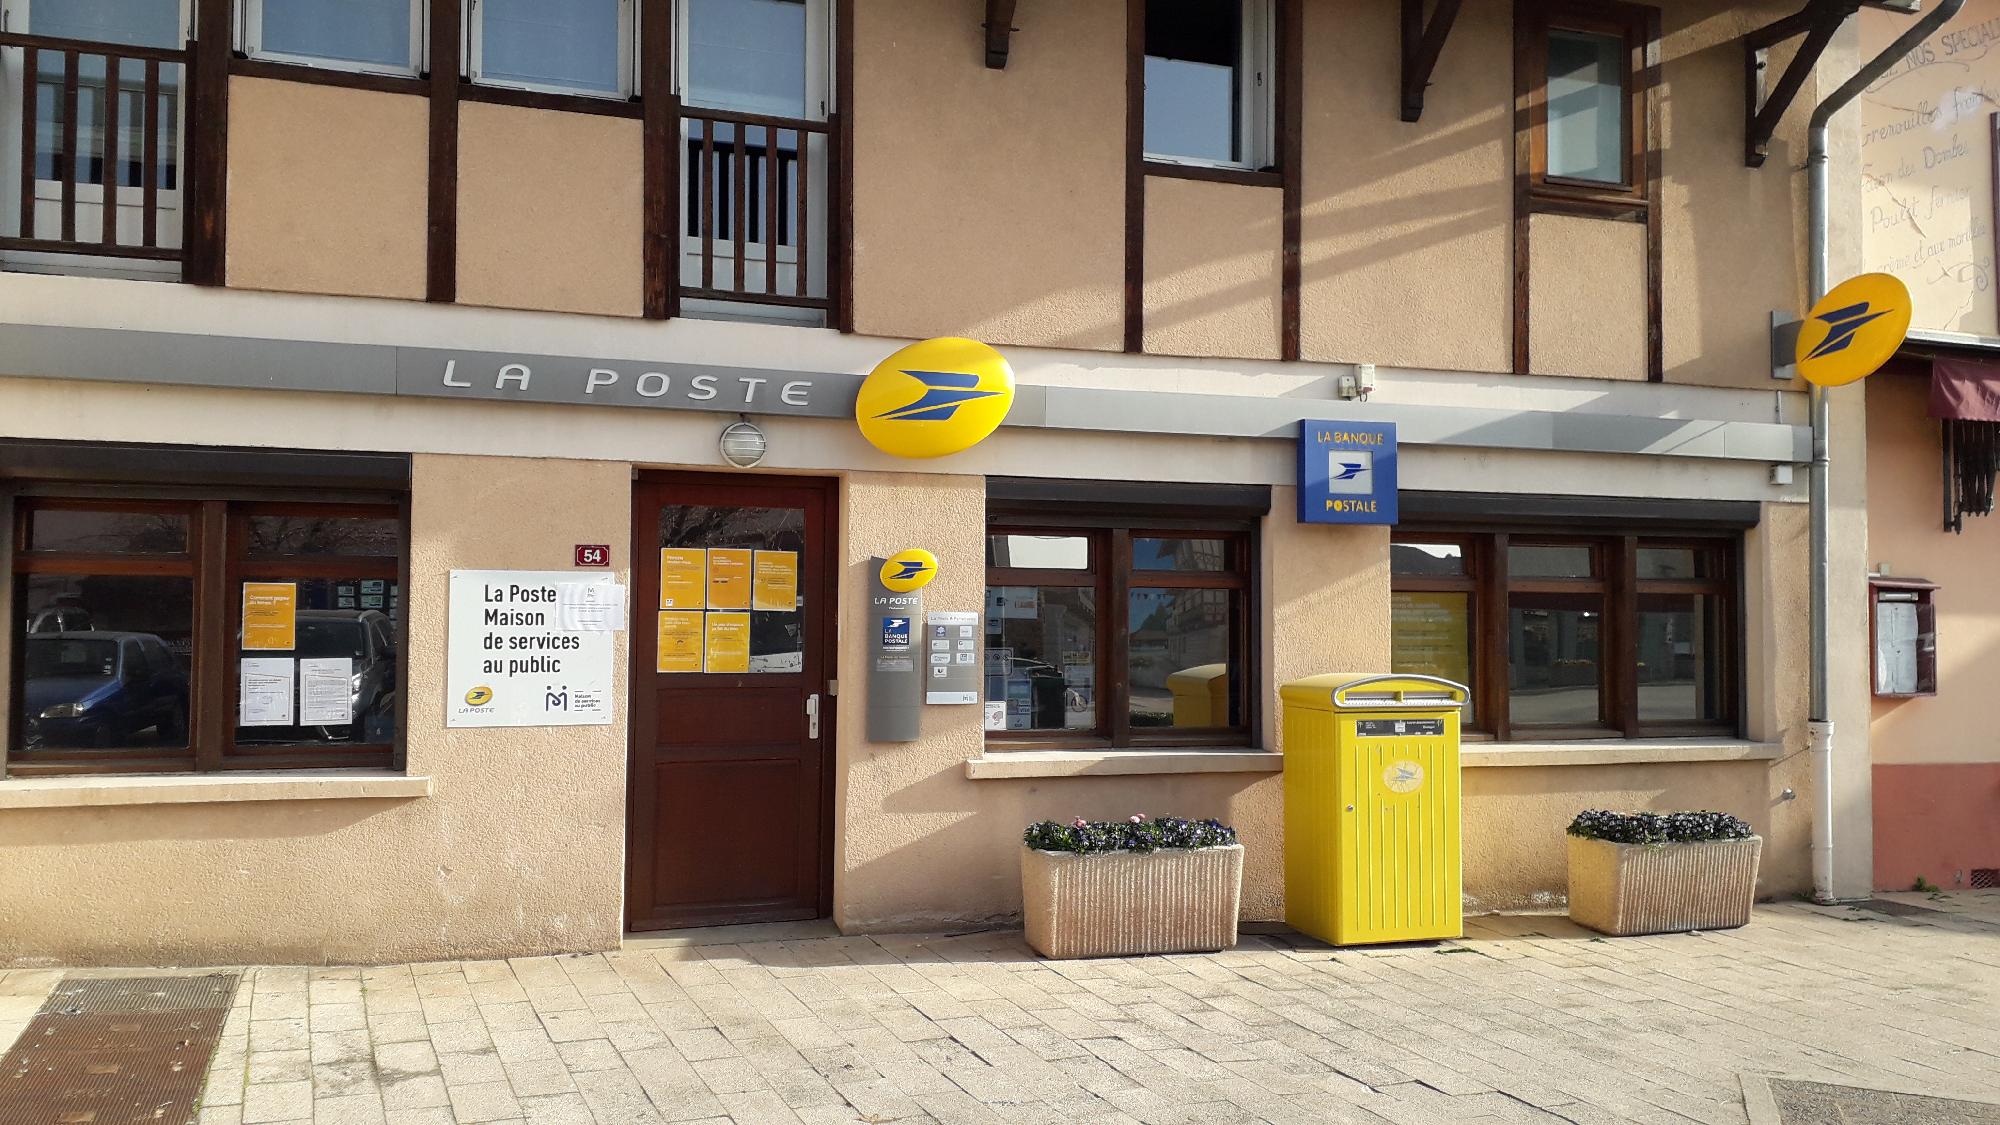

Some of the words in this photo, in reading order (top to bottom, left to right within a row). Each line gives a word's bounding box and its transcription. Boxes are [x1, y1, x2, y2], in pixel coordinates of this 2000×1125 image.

[1905, 41, 1936, 70] NOS
[1870, 197, 1920, 233] Poulet
[442, 359, 531, 392] LA
[585, 368, 814, 407] POSTE
[1317, 431, 1331, 444] LA
[1334, 431, 1384, 446] BANQUE
[1326, 499, 1377, 513] POSTALE
[583, 549, 602, 563] 54
[484, 584, 503, 603] La
[509, 584, 557, 603] Poste
[874, 597, 887, 605] LA
[889, 597, 919, 605] POSTE
[484, 608, 545, 626] Maison
[483, 632, 504, 650] de
[509, 632, 580, 650] services
[483, 658, 503, 674] au
[509, 656, 561, 677] public
